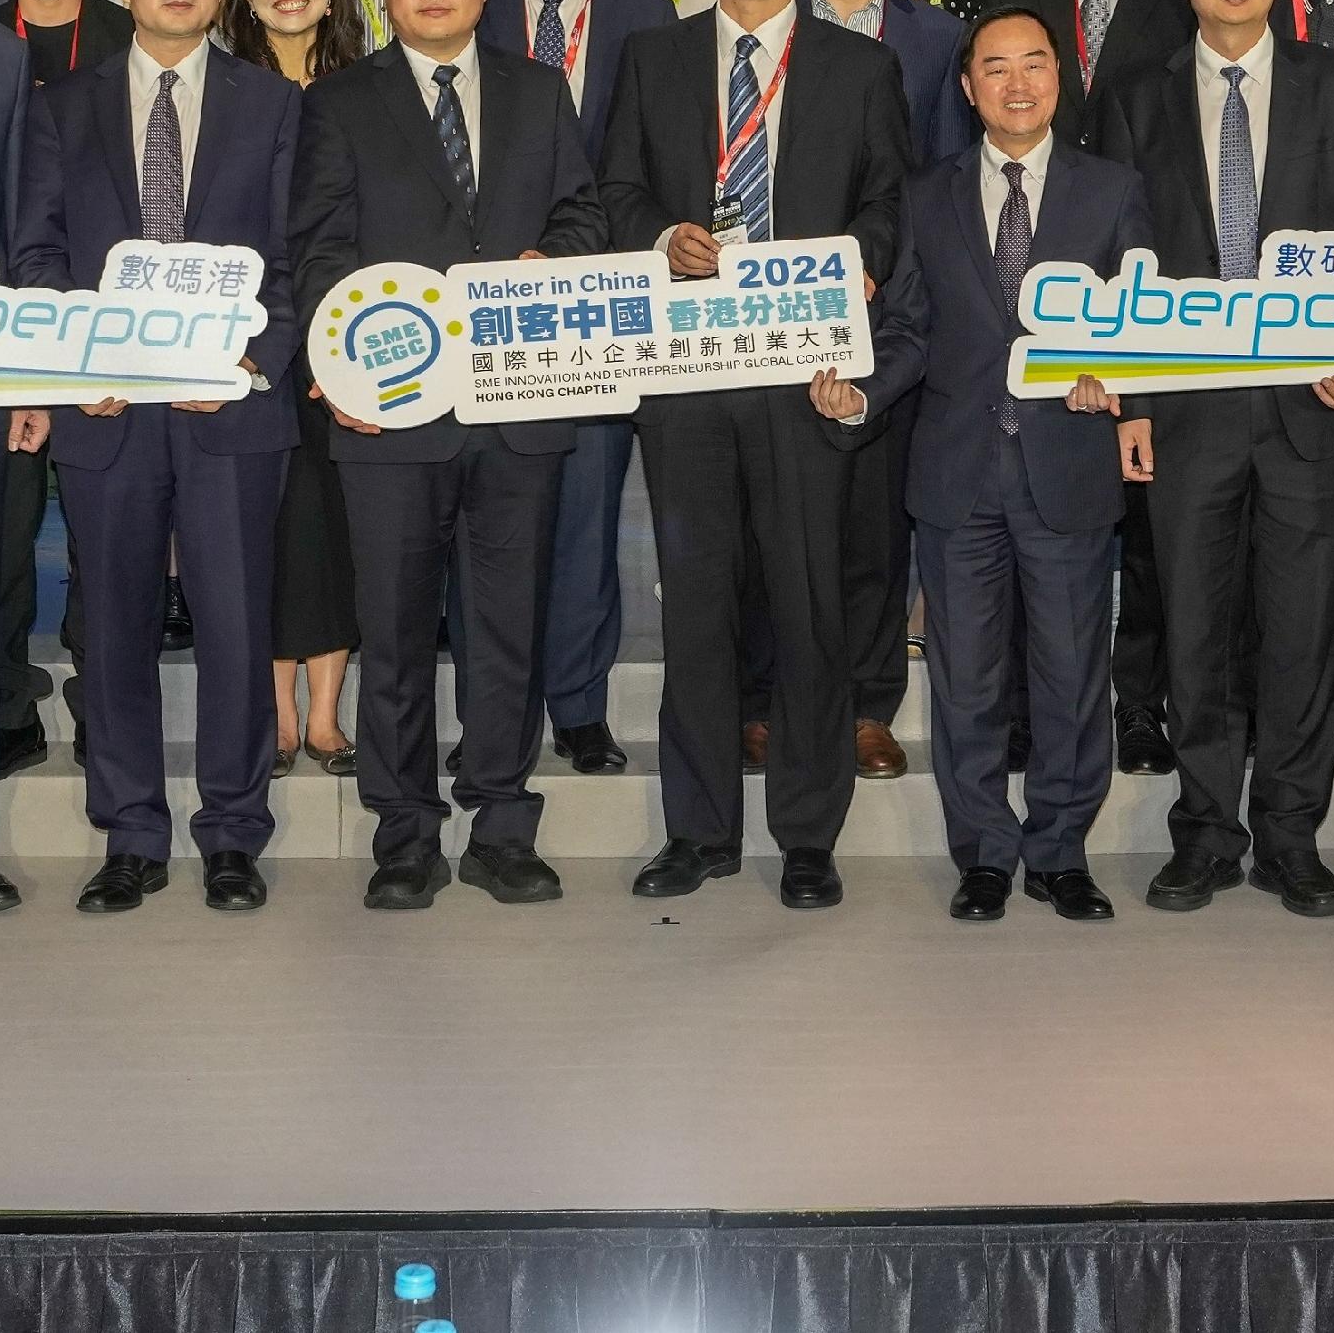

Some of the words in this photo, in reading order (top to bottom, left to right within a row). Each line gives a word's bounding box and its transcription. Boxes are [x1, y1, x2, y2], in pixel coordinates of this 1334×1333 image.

[114, 255, 249, 297] 數碼港
[468, 279, 543, 300] Maker
[551, 276, 572, 295] in
[580, 273, 650, 294] China
[738, 253, 846, 289] 2024
[470, 296, 653, 347] 創客中國
[666, 288, 849, 330] 香港分站賽
[362, 336, 427, 370] IEGC
[363, 322, 419, 350] SME
[472, 326, 853, 373] 國際中小企業創新創業大賽
[475, 375, 502, 388] SME
[505, 371, 581, 386] INNOVATION
[585, 369, 610, 381] AND
[614, 360, 741, 379] ENTREPRENEURSHIP
[745, 355, 794, 368] GLOBAL
[797, 350, 854, 364] CONTEST
[475, 390, 513, 402] HONG
[517, 387, 554, 400] KONG
[558, 384, 618, 398] CHAPTER
